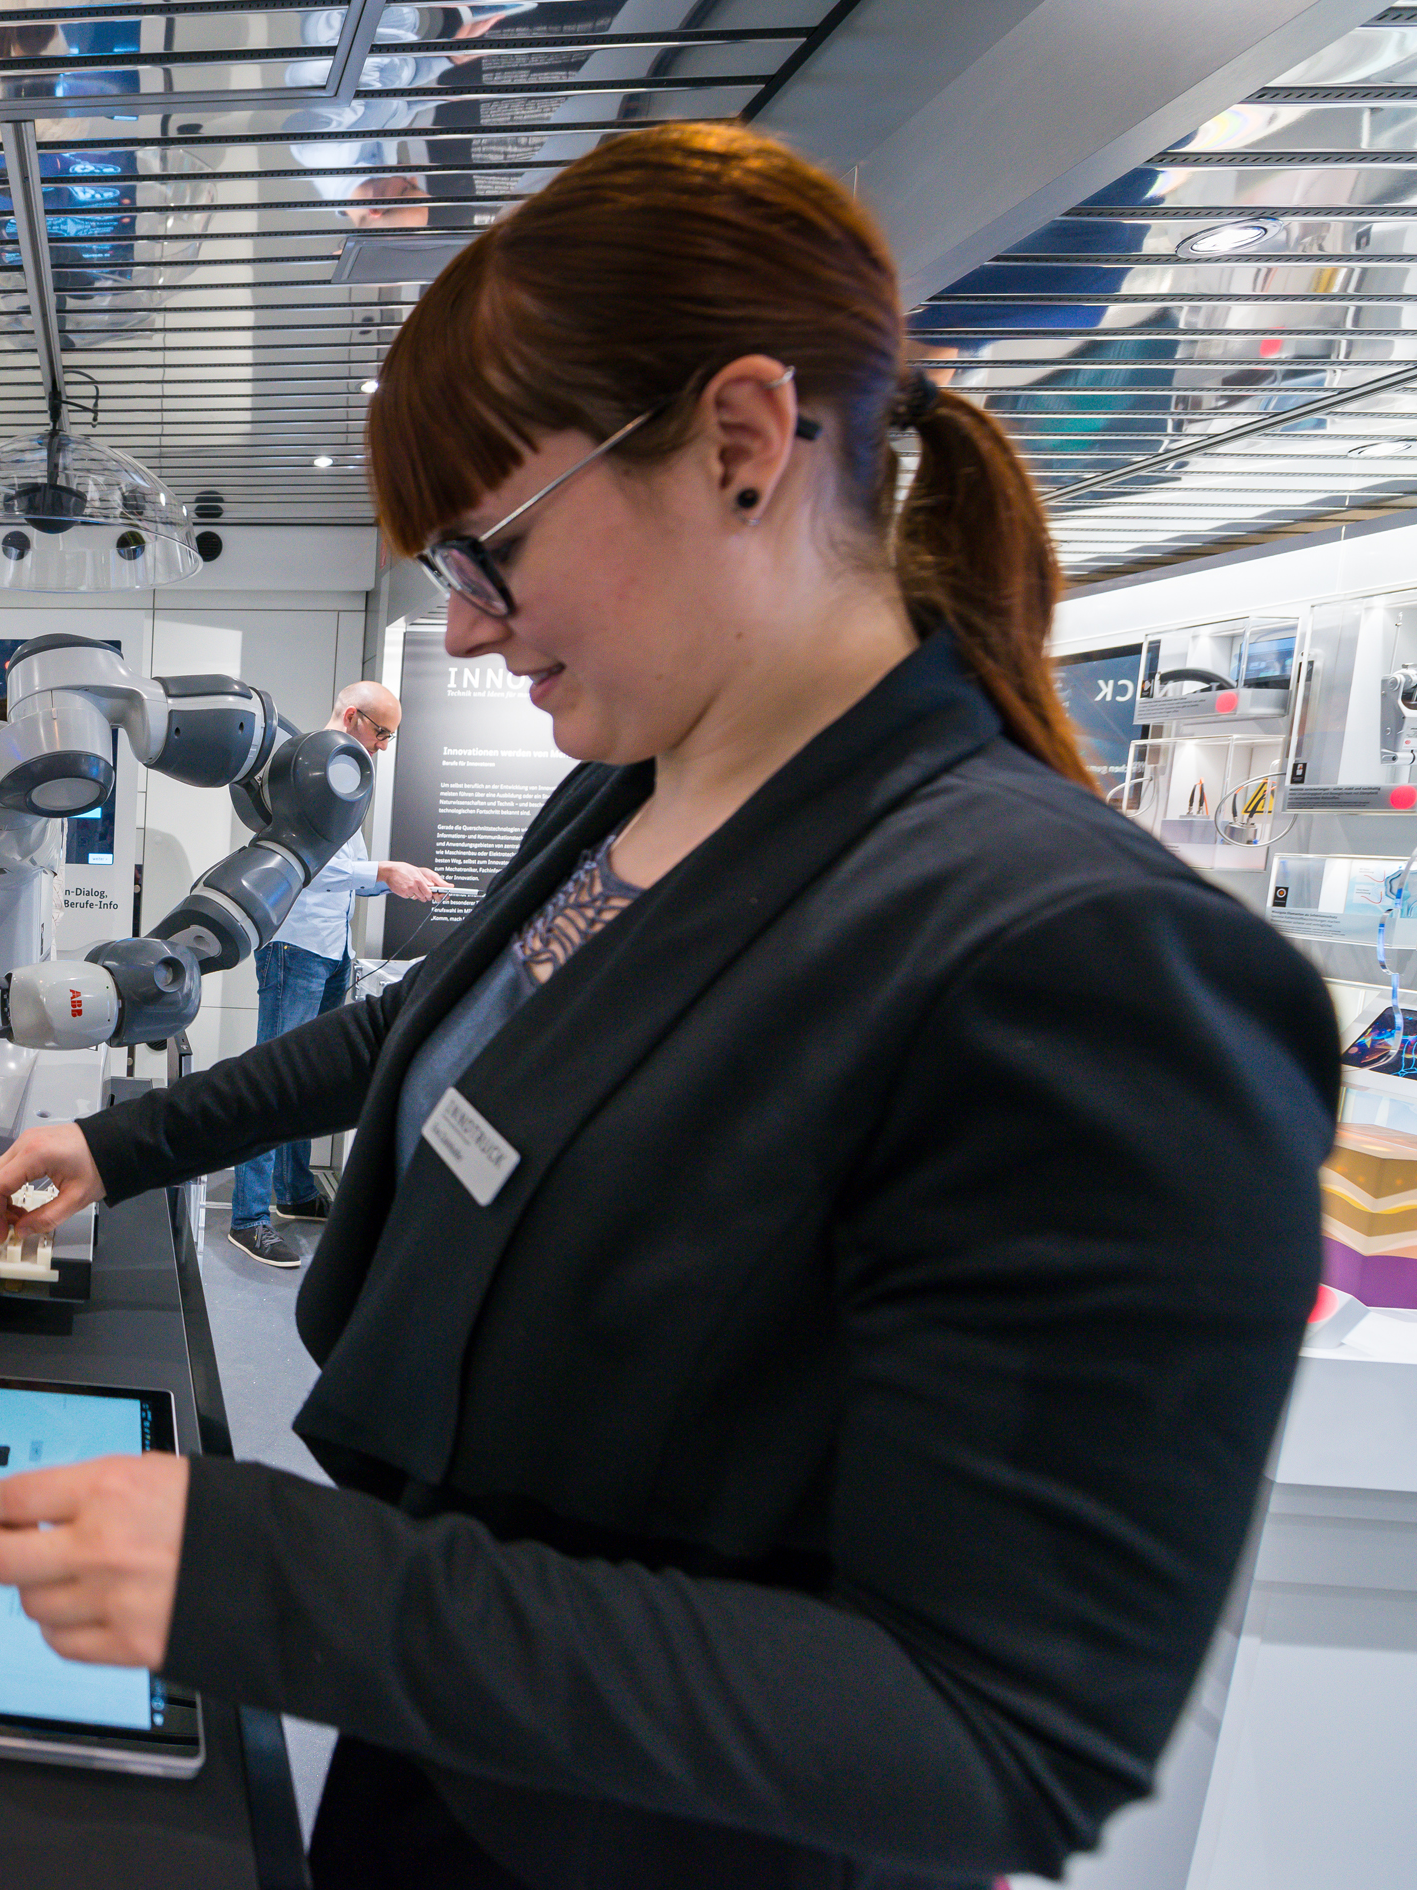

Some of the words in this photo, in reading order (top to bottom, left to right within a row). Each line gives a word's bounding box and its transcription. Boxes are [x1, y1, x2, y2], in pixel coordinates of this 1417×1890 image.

[505, 691, 517, 699] für
[443, 747, 499, 757] Innovationen
[501, 748, 531, 758] werden
[533, 750, 548, 758] von
[446, 841, 494, 849] Anwendungsgebieten
[63, 899, 119, 910] Berufe-Info
[69, 988, 83, 1018] ABB
